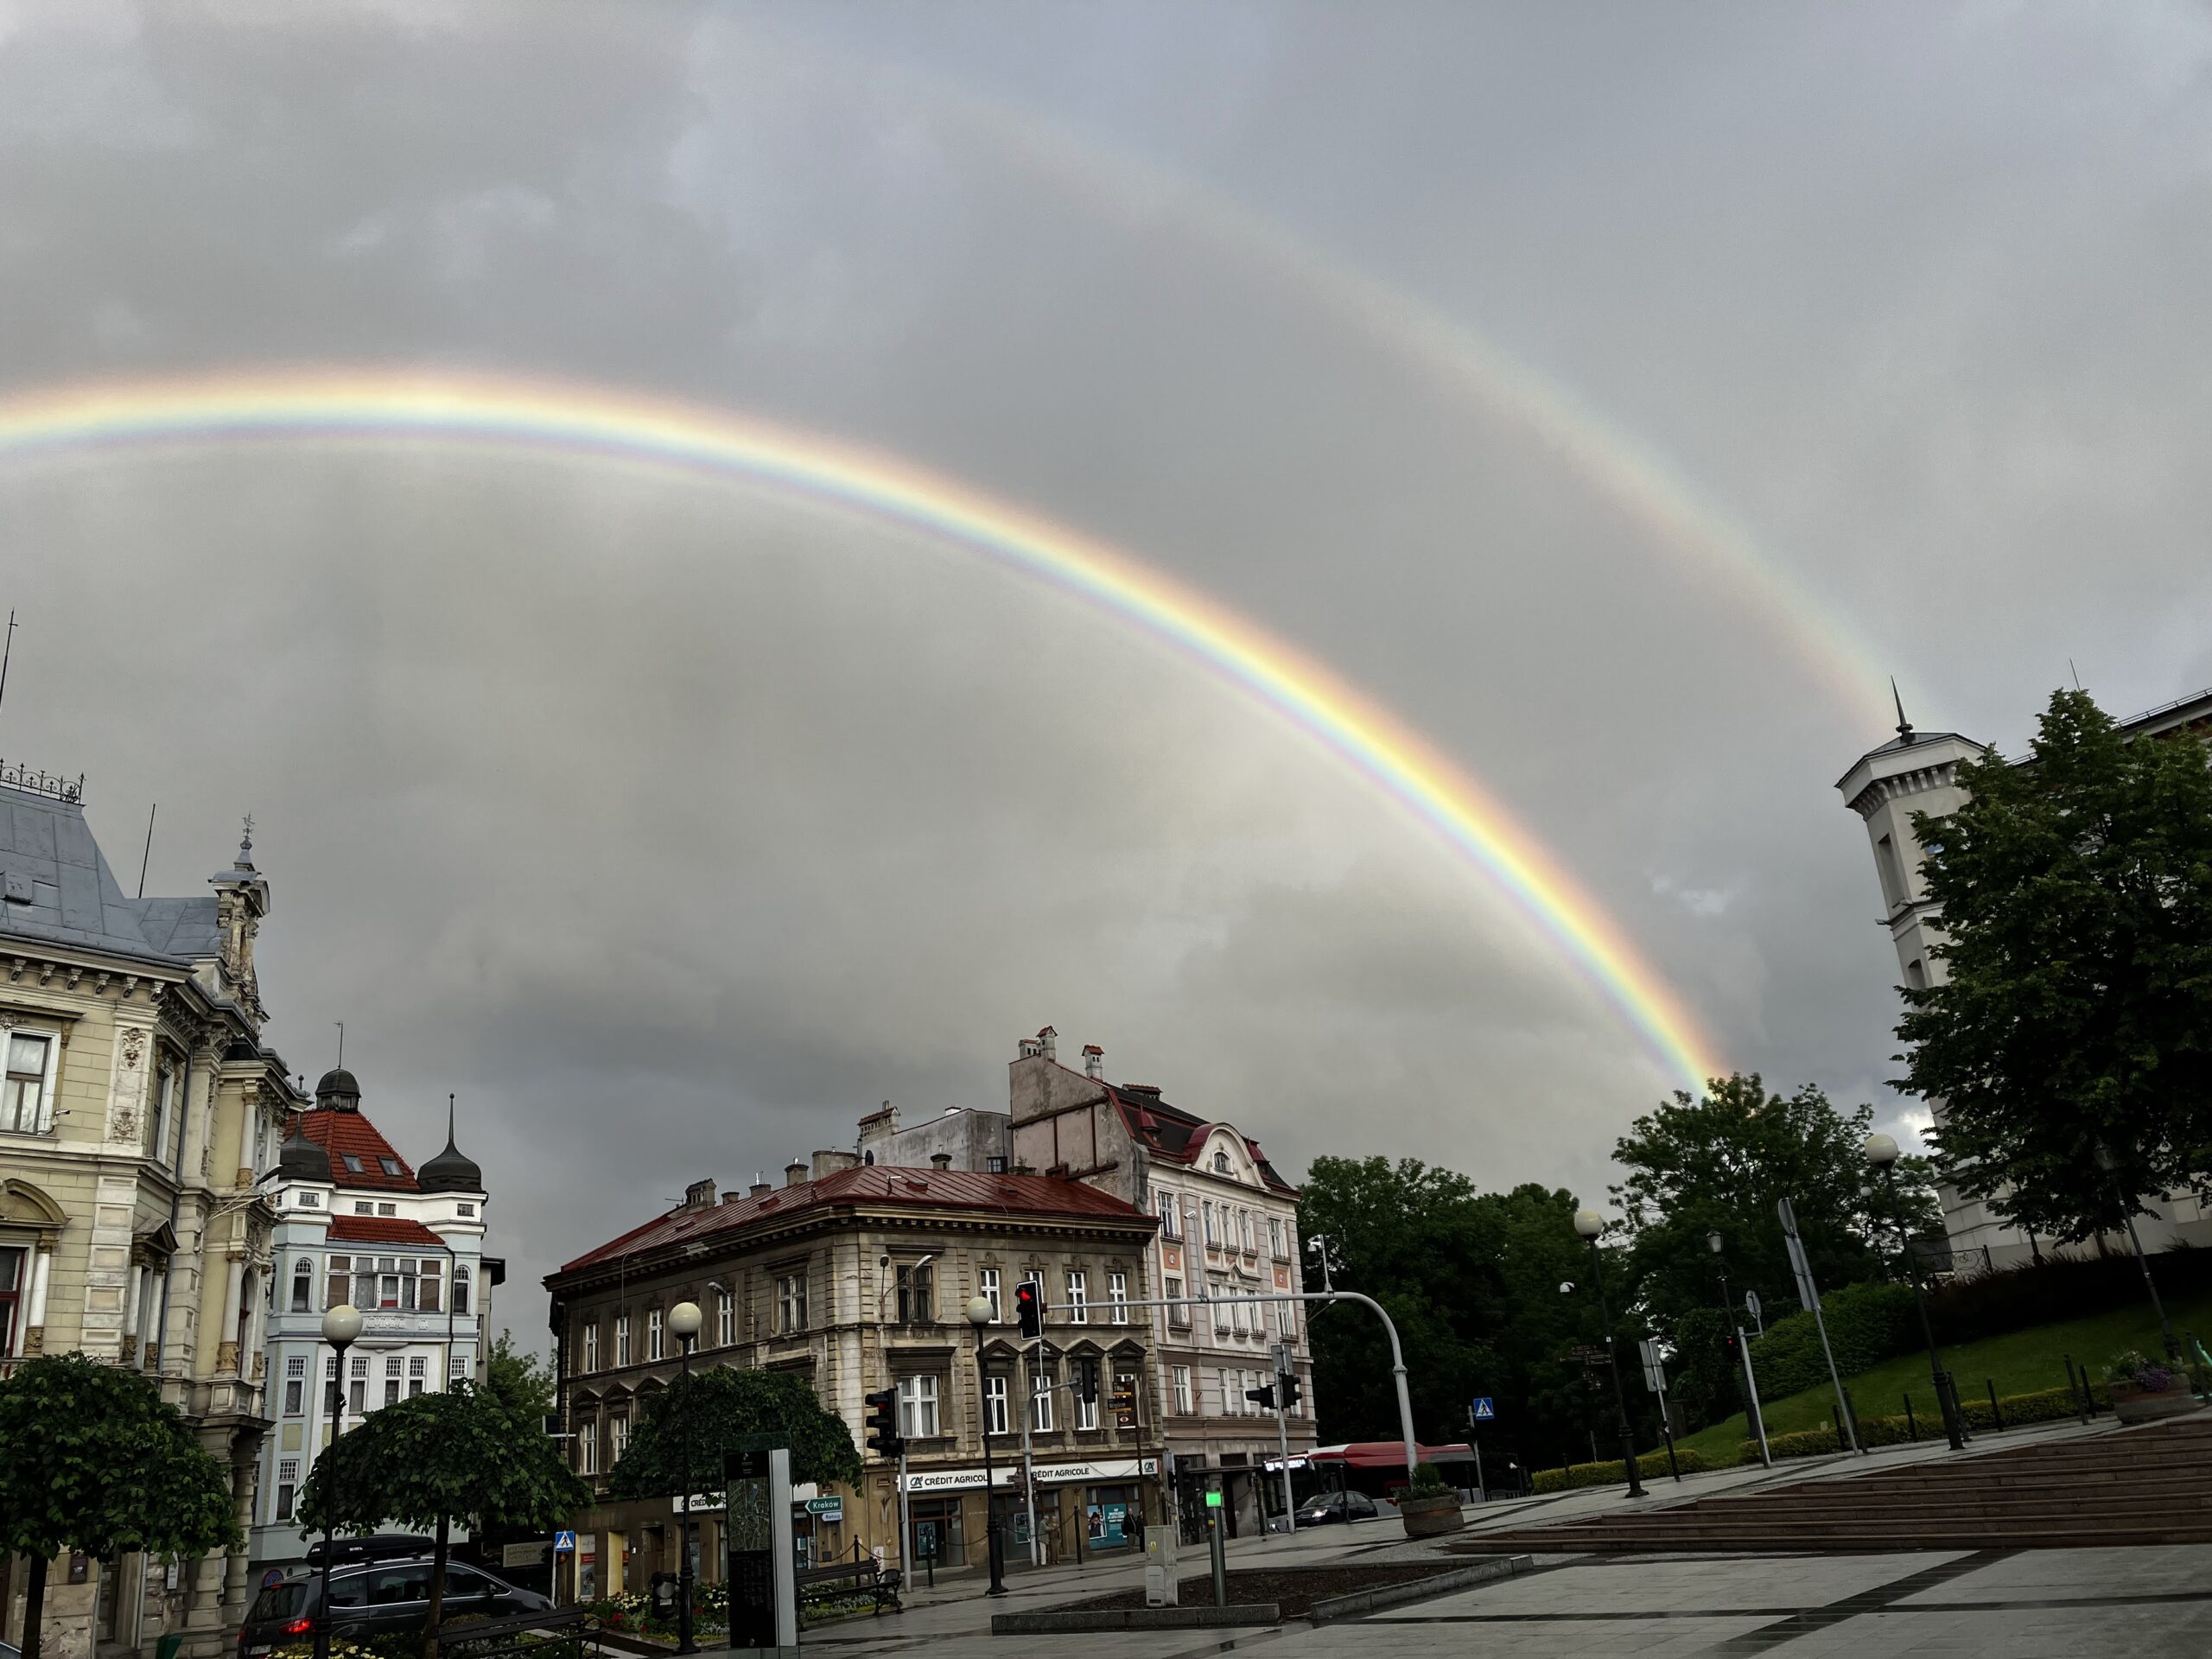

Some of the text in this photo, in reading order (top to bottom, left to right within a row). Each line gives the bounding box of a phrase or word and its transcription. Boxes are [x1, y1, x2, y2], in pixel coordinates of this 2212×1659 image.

[1032, 1467, 1090, 1478] RÉDIT AGRICOLE
[925, 1475, 952, 1486] CRÉDIT
[954, 1474, 988, 1484] AGRICOL
[691, 1498, 708, 1507] CRÉD
[812, 1500, 839, 1509] Kraków
